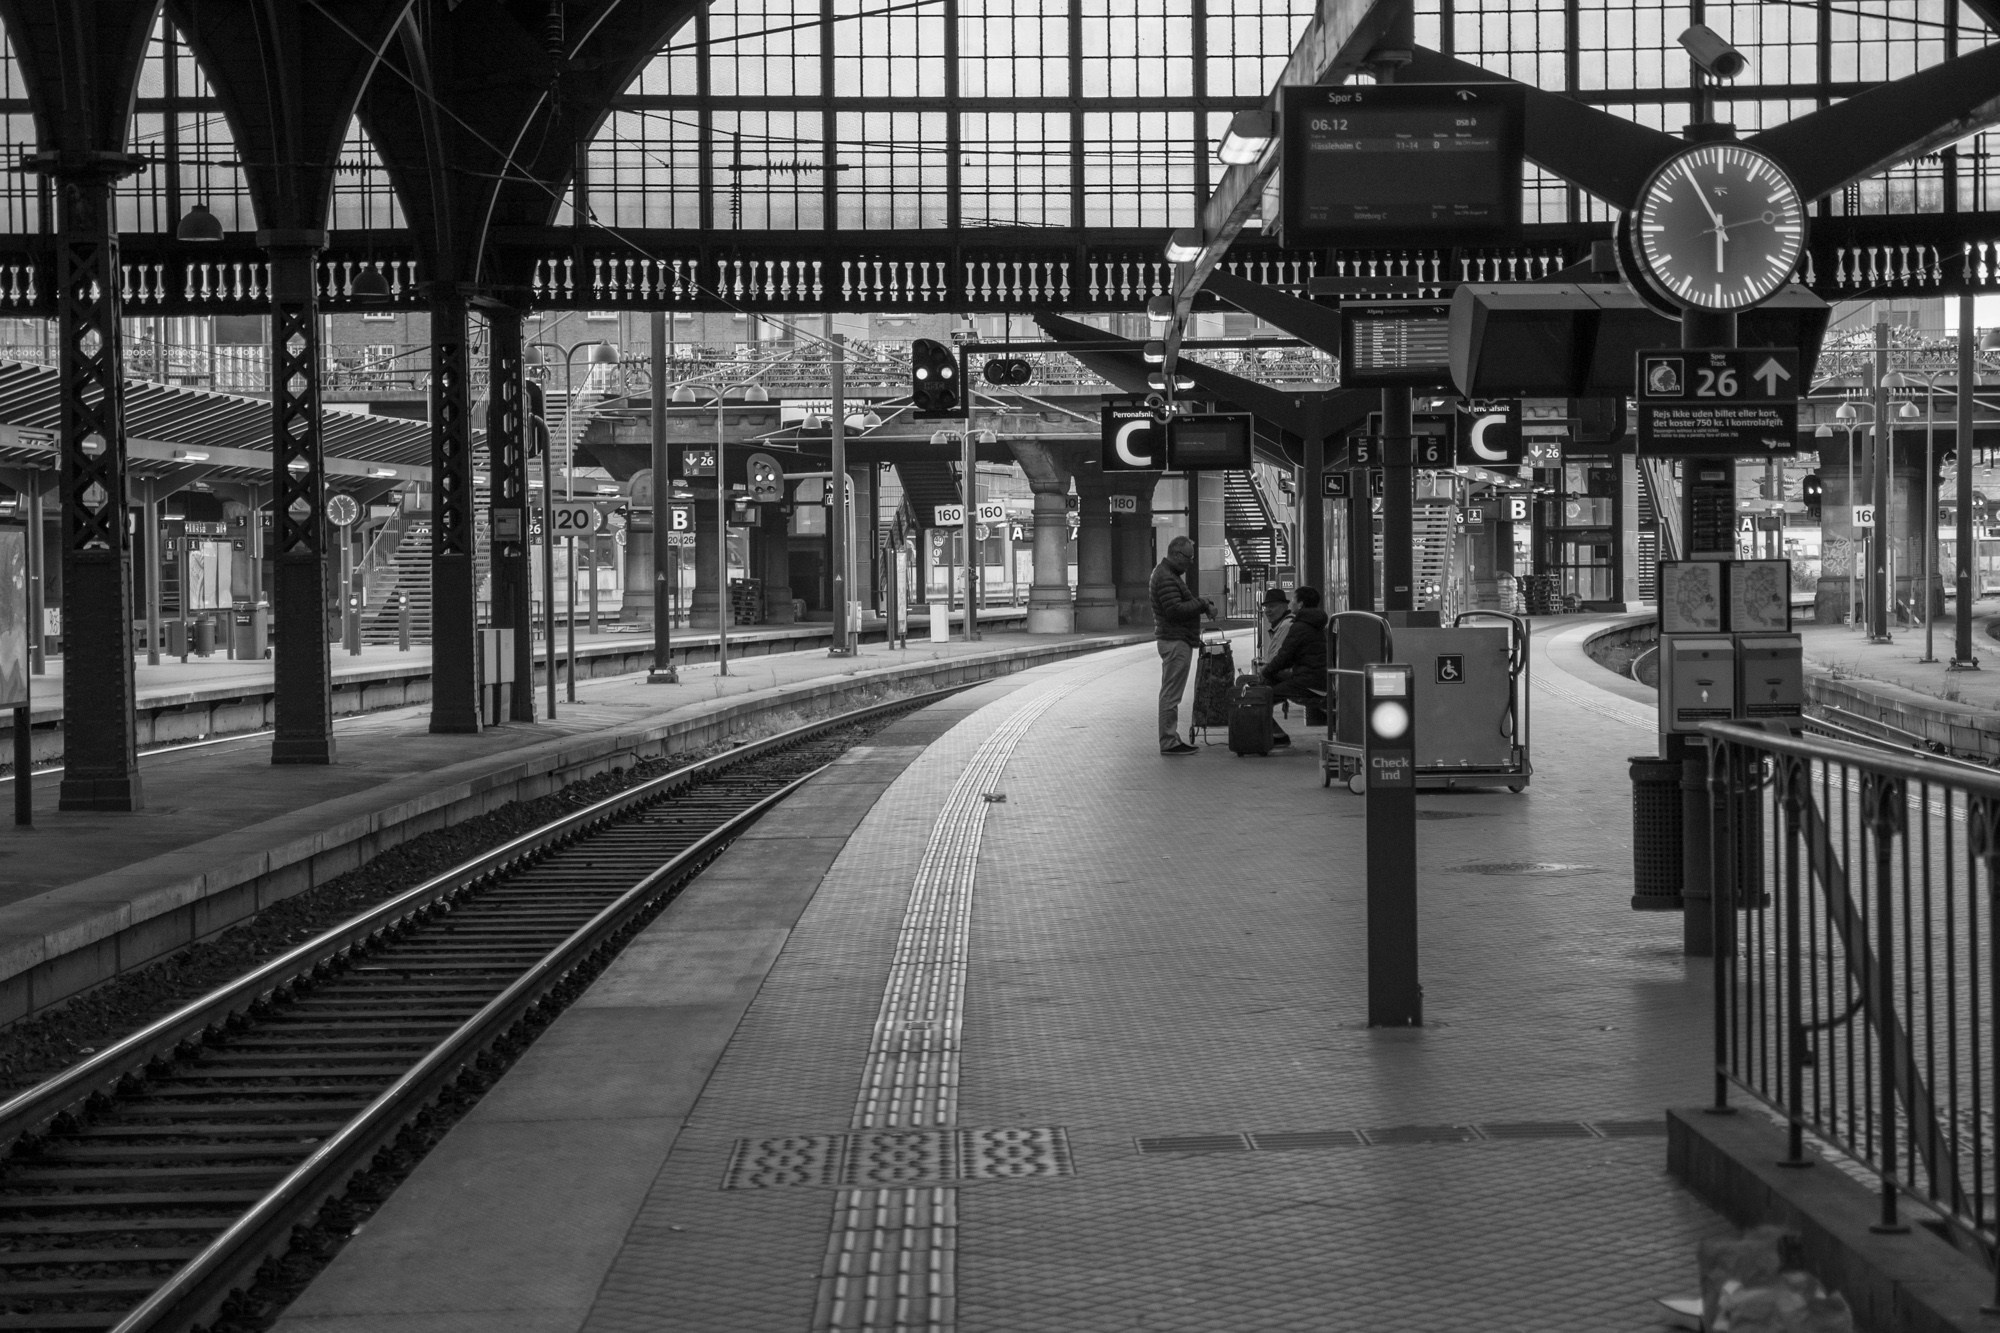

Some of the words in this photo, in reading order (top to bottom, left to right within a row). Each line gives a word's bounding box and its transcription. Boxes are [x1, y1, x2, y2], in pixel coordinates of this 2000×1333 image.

[1329, 93, 1351, 104] Spor
[1355, 93, 1362, 102] 5
[1311, 119, 1348, 130] 06.12
[1311, 142, 1353, 150] Hässleholm
[1355, 142, 1362, 150] C
[1396, 142, 1418, 150] 11-14
[1710, 353, 1726, 361] Spor
[1697, 369, 1738, 397] 26
[1653, 410, 1671, 419] Rejs
[1672, 410, 1690, 418] ikke
[1692, 410, 1713, 418] uden
[1715, 409, 1737, 418] billet
[1738, 409, 1757, 418] eller
[1758, 409, 1778, 418] kort,
[1653, 419, 1667, 427] det
[1669, 419, 1695, 427] koster
[1696, 419, 1712, 427] 750
[1714, 419, 1724, 427] kr.
[1731, 418, 1783, 428] kontrolafgift
[1116, 420, 1152, 466] C
[1472, 414, 1508, 461] C
[1357, 447, 1369, 462] 5
[1426, 446, 1438, 461] 6
[1546, 449, 1559, 458] 26
[700, 456, 714, 466] 26
[1114, 498, 1134, 509] 180
[938, 509, 961, 521] 160
[979, 506, 1002, 518] 160
[1511, 500, 1526, 520] B
[552, 510, 589, 529] 120
[673, 510, 688, 530] B
[1741, 518, 1754, 531] A
[1012, 527, 1023, 540] A
[683, 536, 694, 544] 26
[1372, 757, 1410, 768] Check
[1381, 770, 1400, 780] ind
